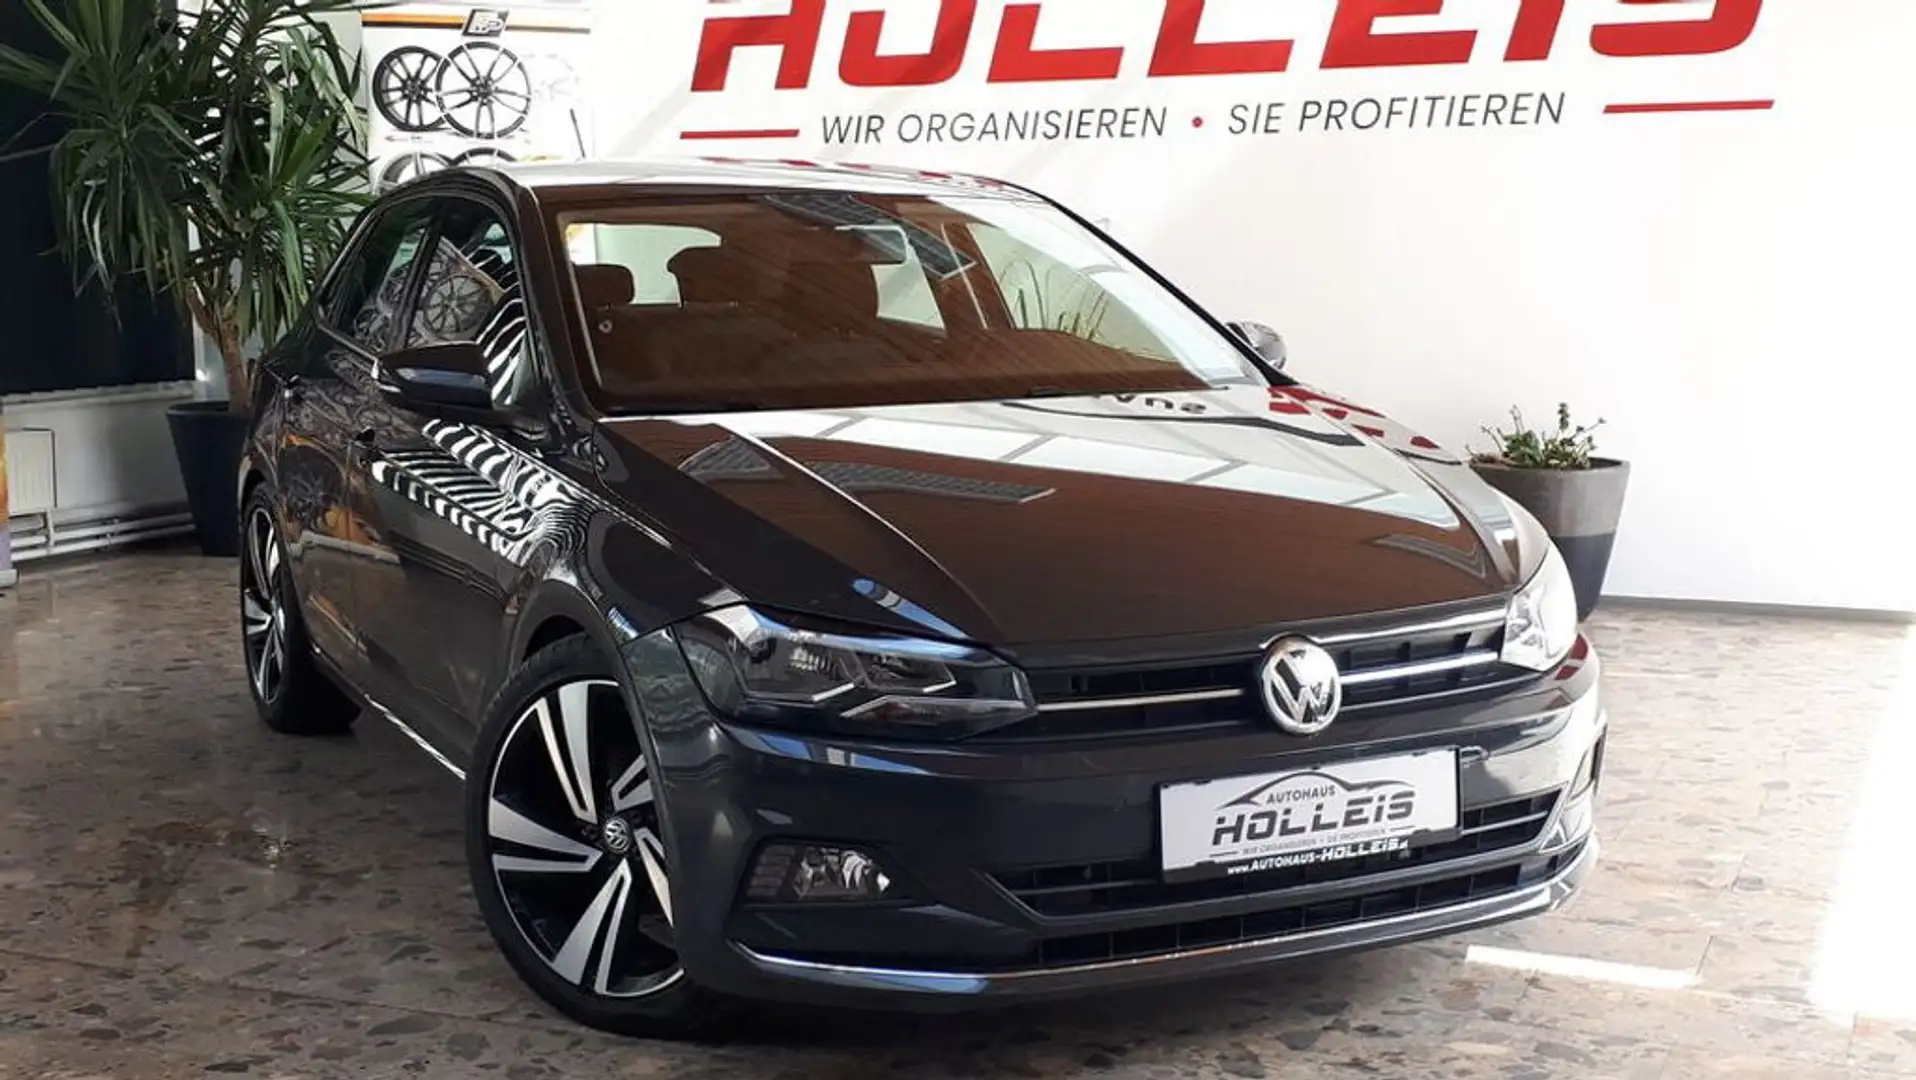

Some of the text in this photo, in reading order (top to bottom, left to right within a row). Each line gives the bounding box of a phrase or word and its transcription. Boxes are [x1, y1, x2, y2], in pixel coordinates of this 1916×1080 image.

[822, 92, 1565, 144] WIR ORGANISIEREN SIE PROFITIEREN
[1266, 785, 1336, 804] AUTOHAUS
